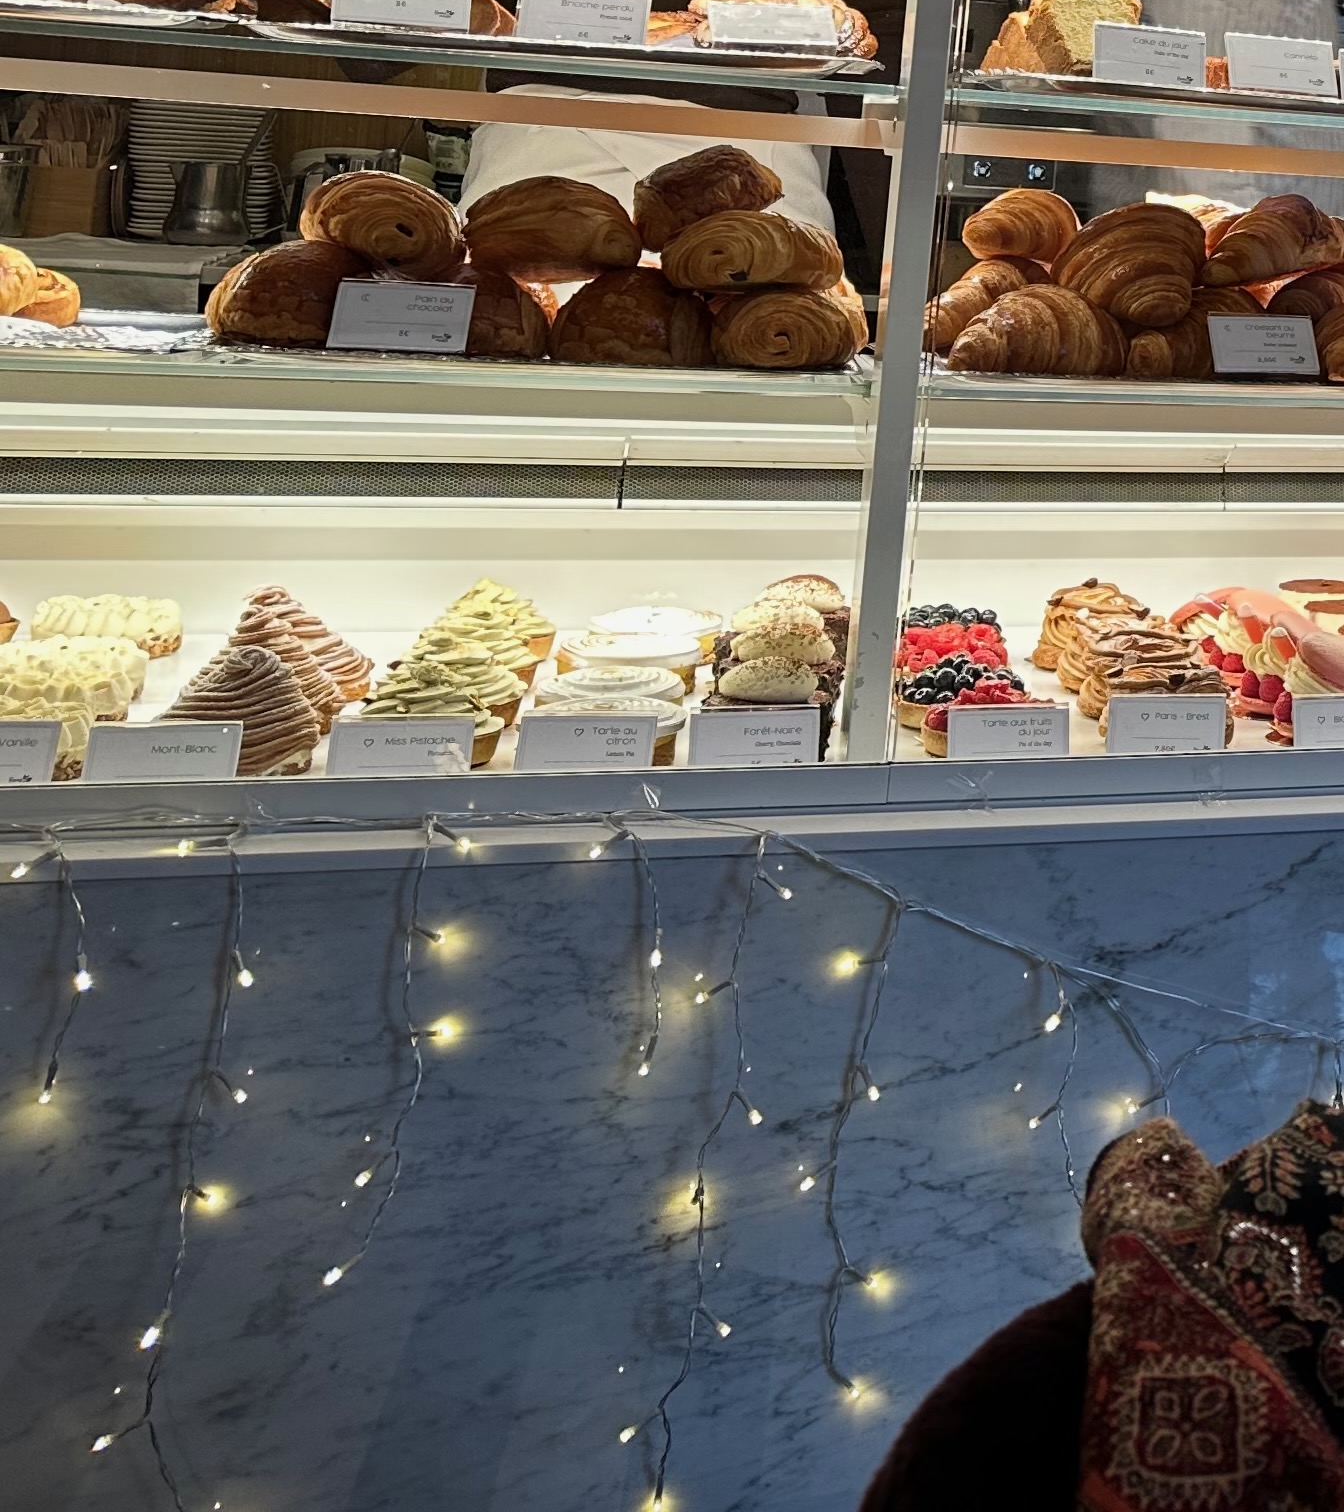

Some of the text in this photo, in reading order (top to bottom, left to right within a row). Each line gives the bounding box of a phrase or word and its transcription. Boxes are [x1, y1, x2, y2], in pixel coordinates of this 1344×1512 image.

[1132, 36, 1189, 54] Cake du jour
[415, 294, 455, 305] Pain au
[407, 303, 454, 314] chocolat
[1265, 331, 1296, 340] beurre
[982, 718, 1008, 729] Tarte
[1010, 718, 1029, 727] aux
[593, 725, 639, 737] Tarte au
[1018, 725, 1032, 737] du
[384, 735, 408, 747] Miss
[606, 736, 637, 747] citron
[151, 742, 218, 755] Mont-Blanc
